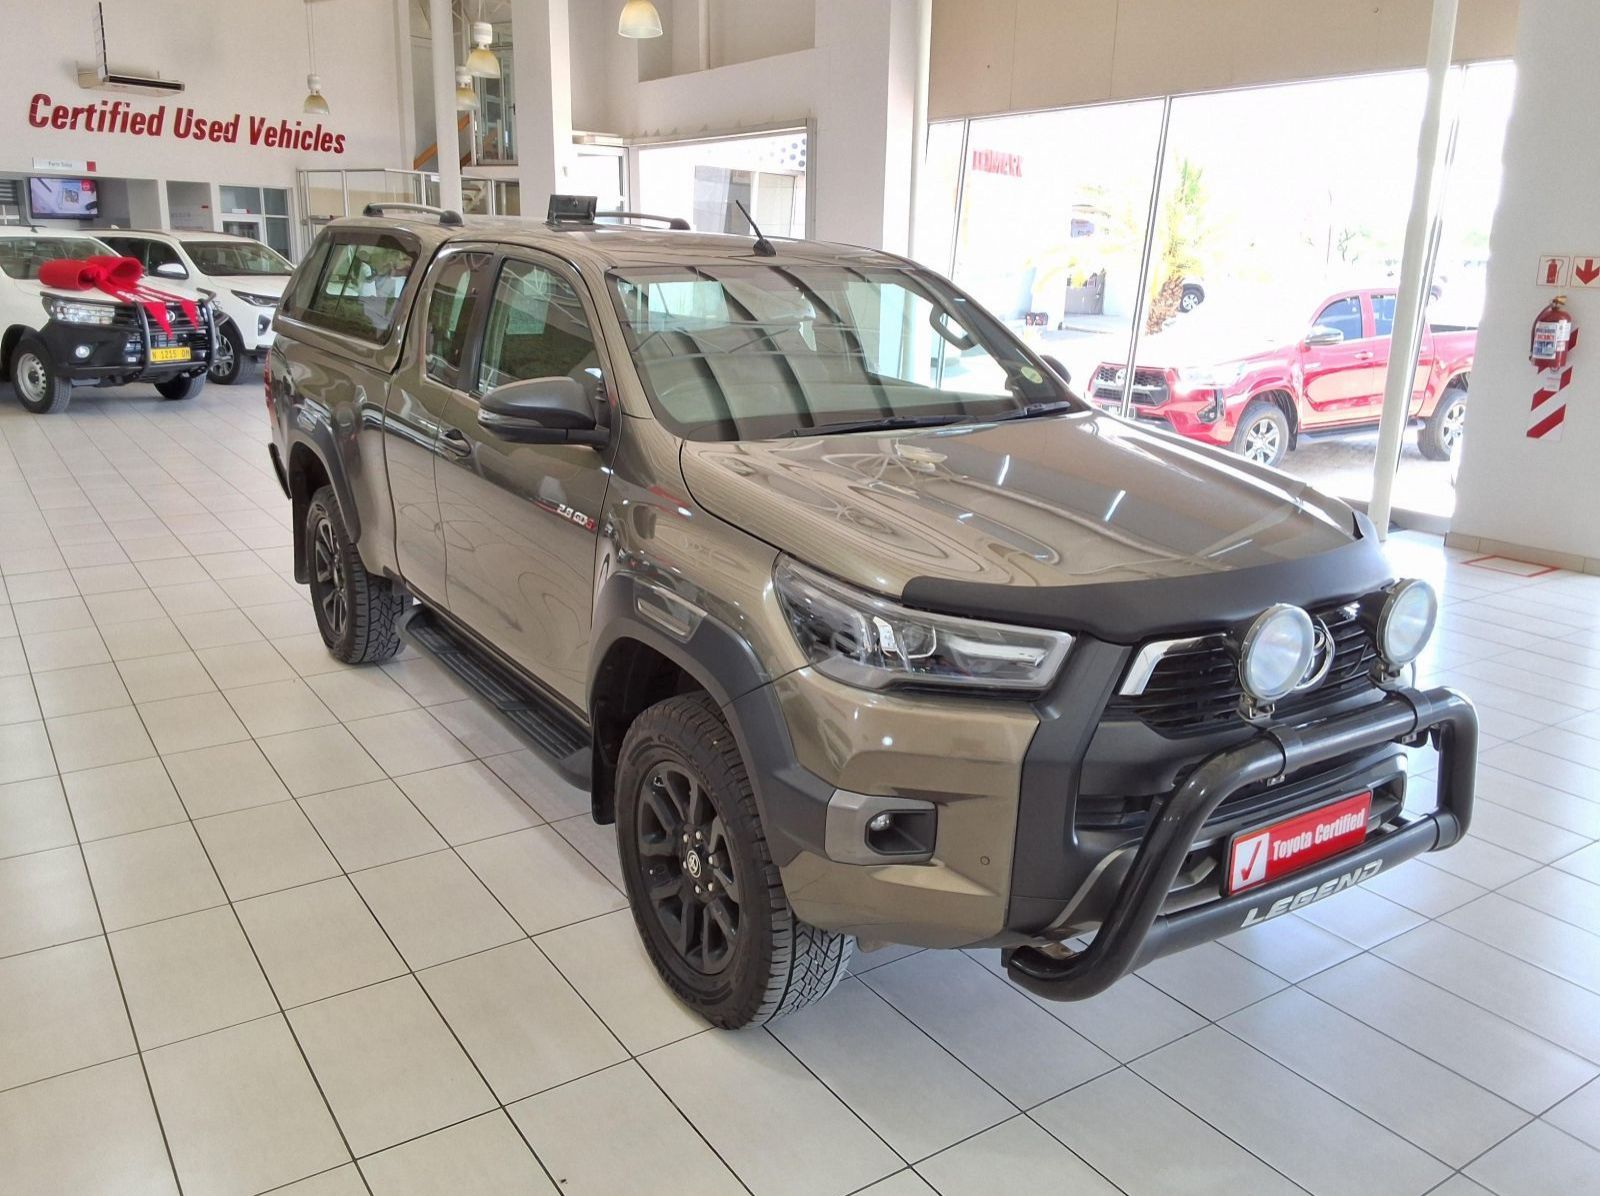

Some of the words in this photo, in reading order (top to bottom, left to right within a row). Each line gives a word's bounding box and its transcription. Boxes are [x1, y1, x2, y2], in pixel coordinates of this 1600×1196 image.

[29, 93, 165, 136] Certified
[173, 107, 241, 143] Used
[249, 115, 346, 154] Vehicles
[1273, 831, 1312, 861] Toyota
[1314, 808, 1366, 845] Certified
[1241, 858, 1383, 928] LEGEND
